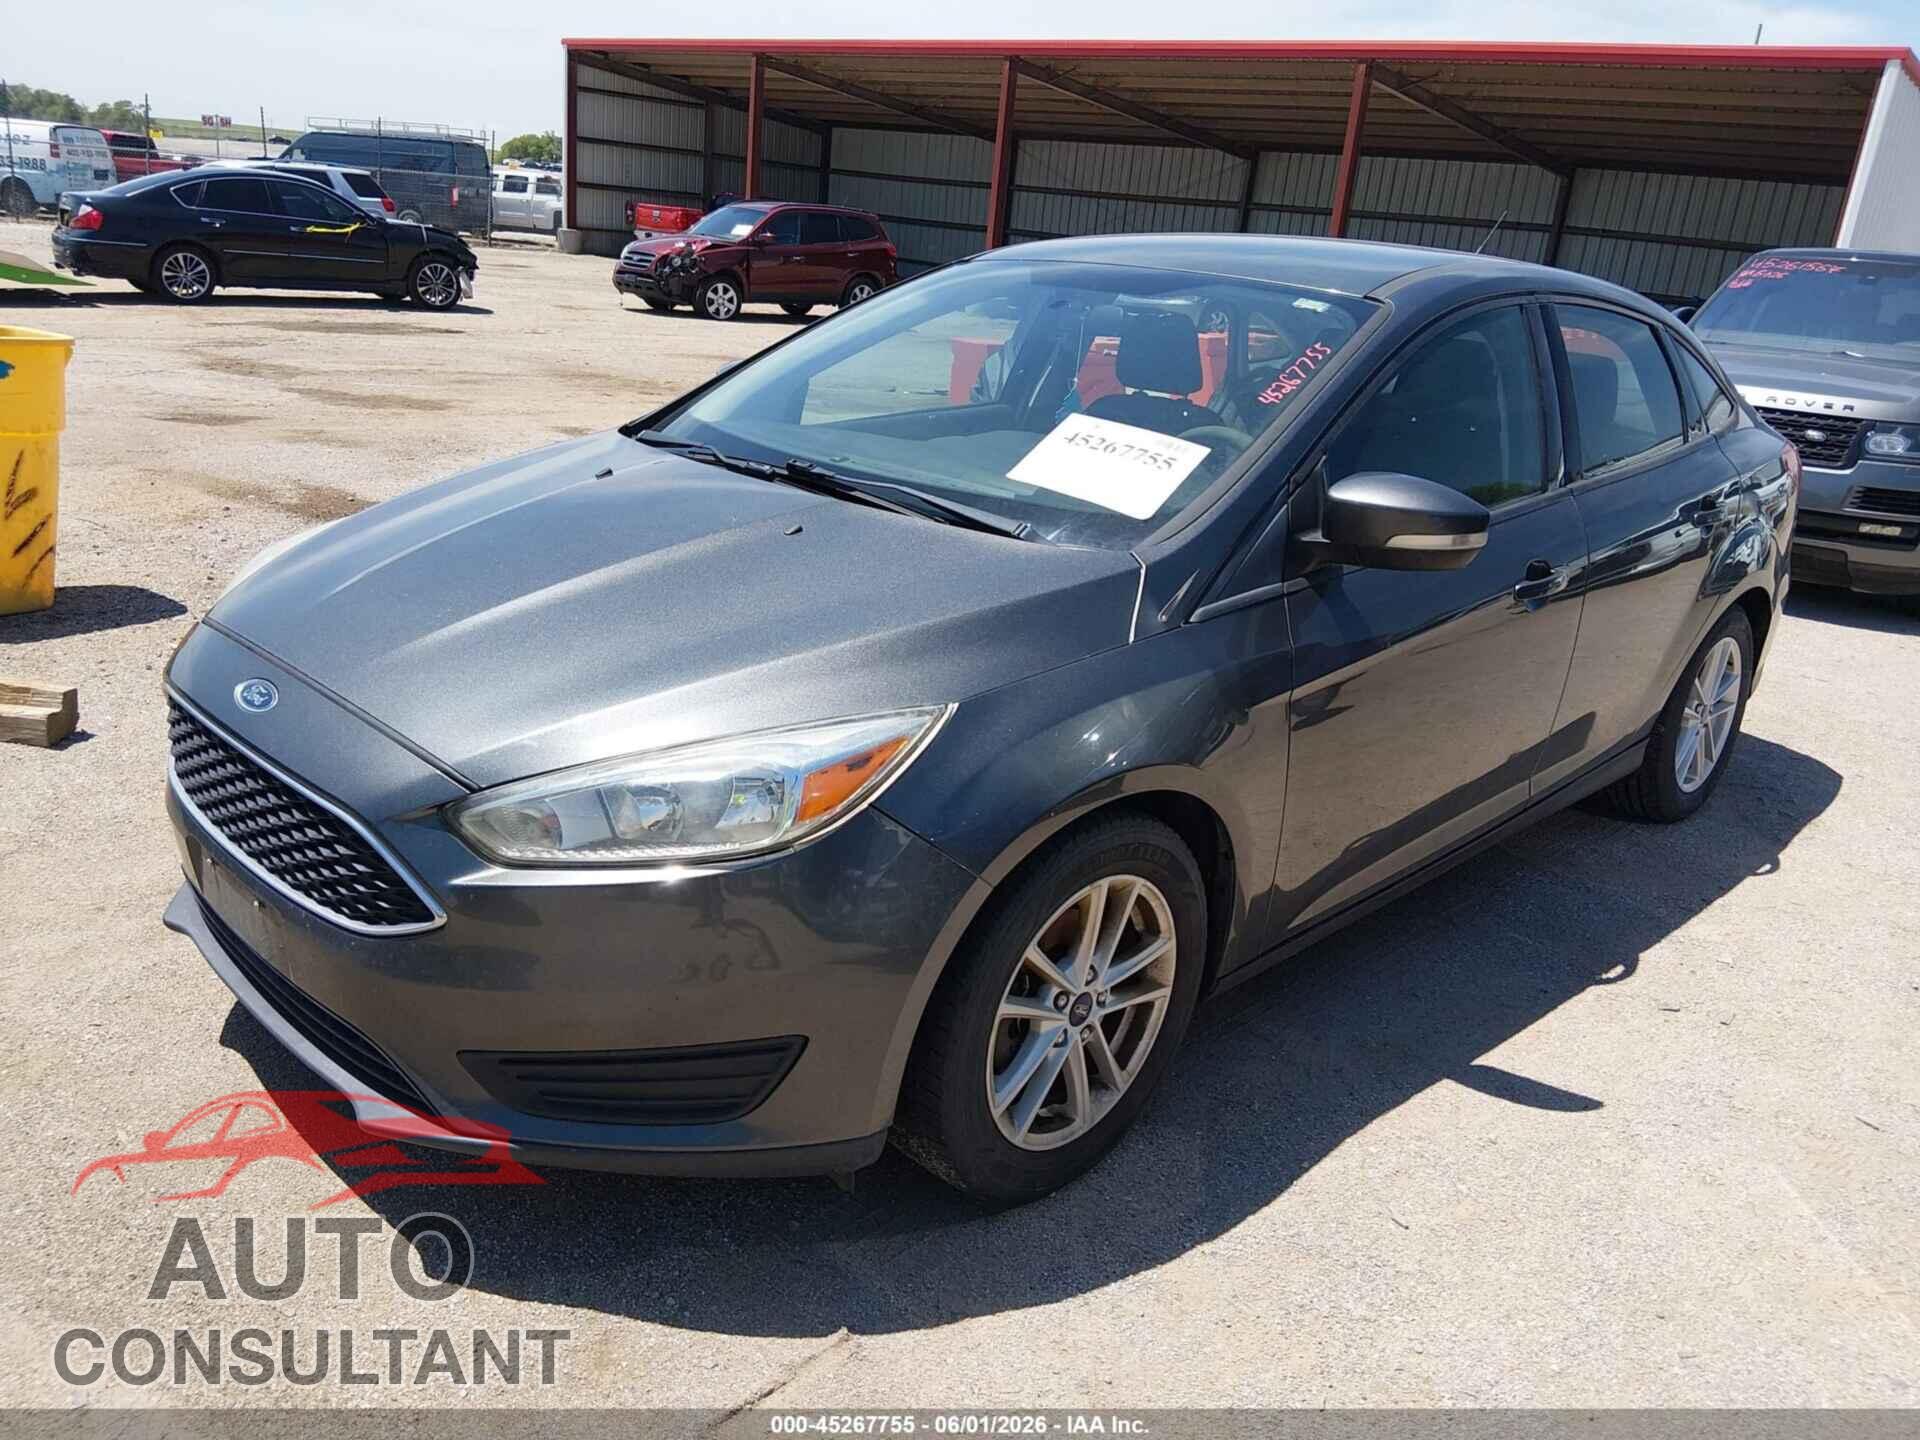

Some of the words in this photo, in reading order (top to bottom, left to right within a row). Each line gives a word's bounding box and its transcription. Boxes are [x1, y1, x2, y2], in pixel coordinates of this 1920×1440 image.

[1257, 341, 1332, 404] 45267755
[1766, 396, 1855, 412] ROVER
[1064, 431, 1177, 471] 45267755
